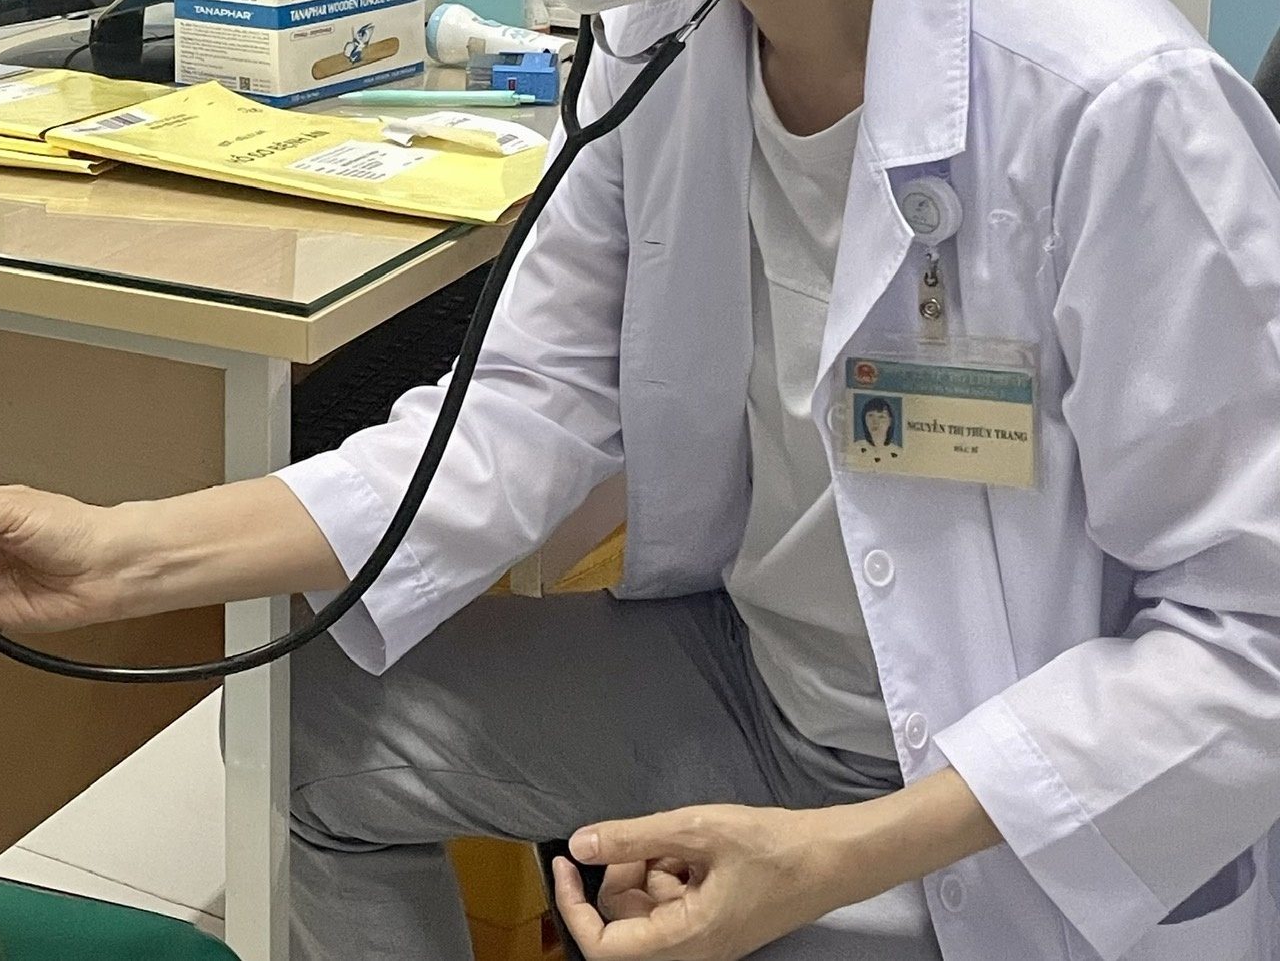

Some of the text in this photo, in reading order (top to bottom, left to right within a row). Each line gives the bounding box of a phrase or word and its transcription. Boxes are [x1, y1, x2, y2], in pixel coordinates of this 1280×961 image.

[193, 5, 252, 21] TANAPHAR
[290, 5, 327, 22] TANAPHAR
[994, 428, 1028, 442] TRANG
